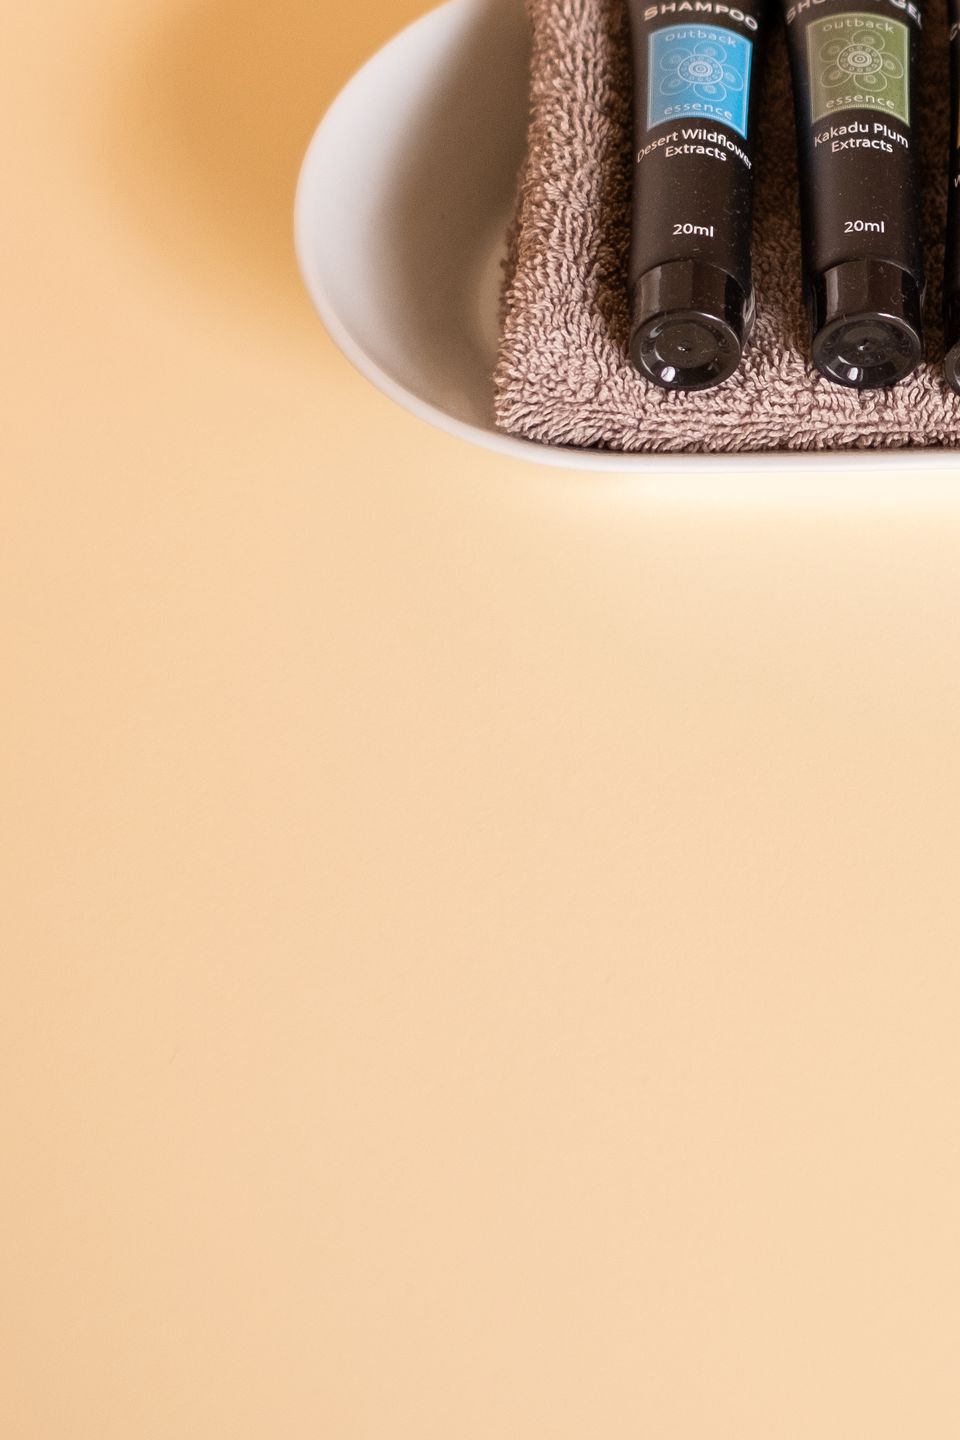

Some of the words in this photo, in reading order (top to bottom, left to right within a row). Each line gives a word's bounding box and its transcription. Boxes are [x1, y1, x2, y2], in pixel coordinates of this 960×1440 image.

[644, 1, 758, 31] SHAMPOO
[822, 17, 895, 33] outback
[664, 30, 737, 47] outback
[825, 93, 896, 109] essence
[663, 103, 733, 120] essence
[814, 121, 869, 147] Kakadu
[873, 122, 909, 148] Plum
[637, 131, 679, 163] Desert
[665, 144, 727, 161] Extracts
[831, 138, 893, 153] Extracts
[672, 223, 714, 238] 20ml
[844, 220, 885, 234] 20ml
